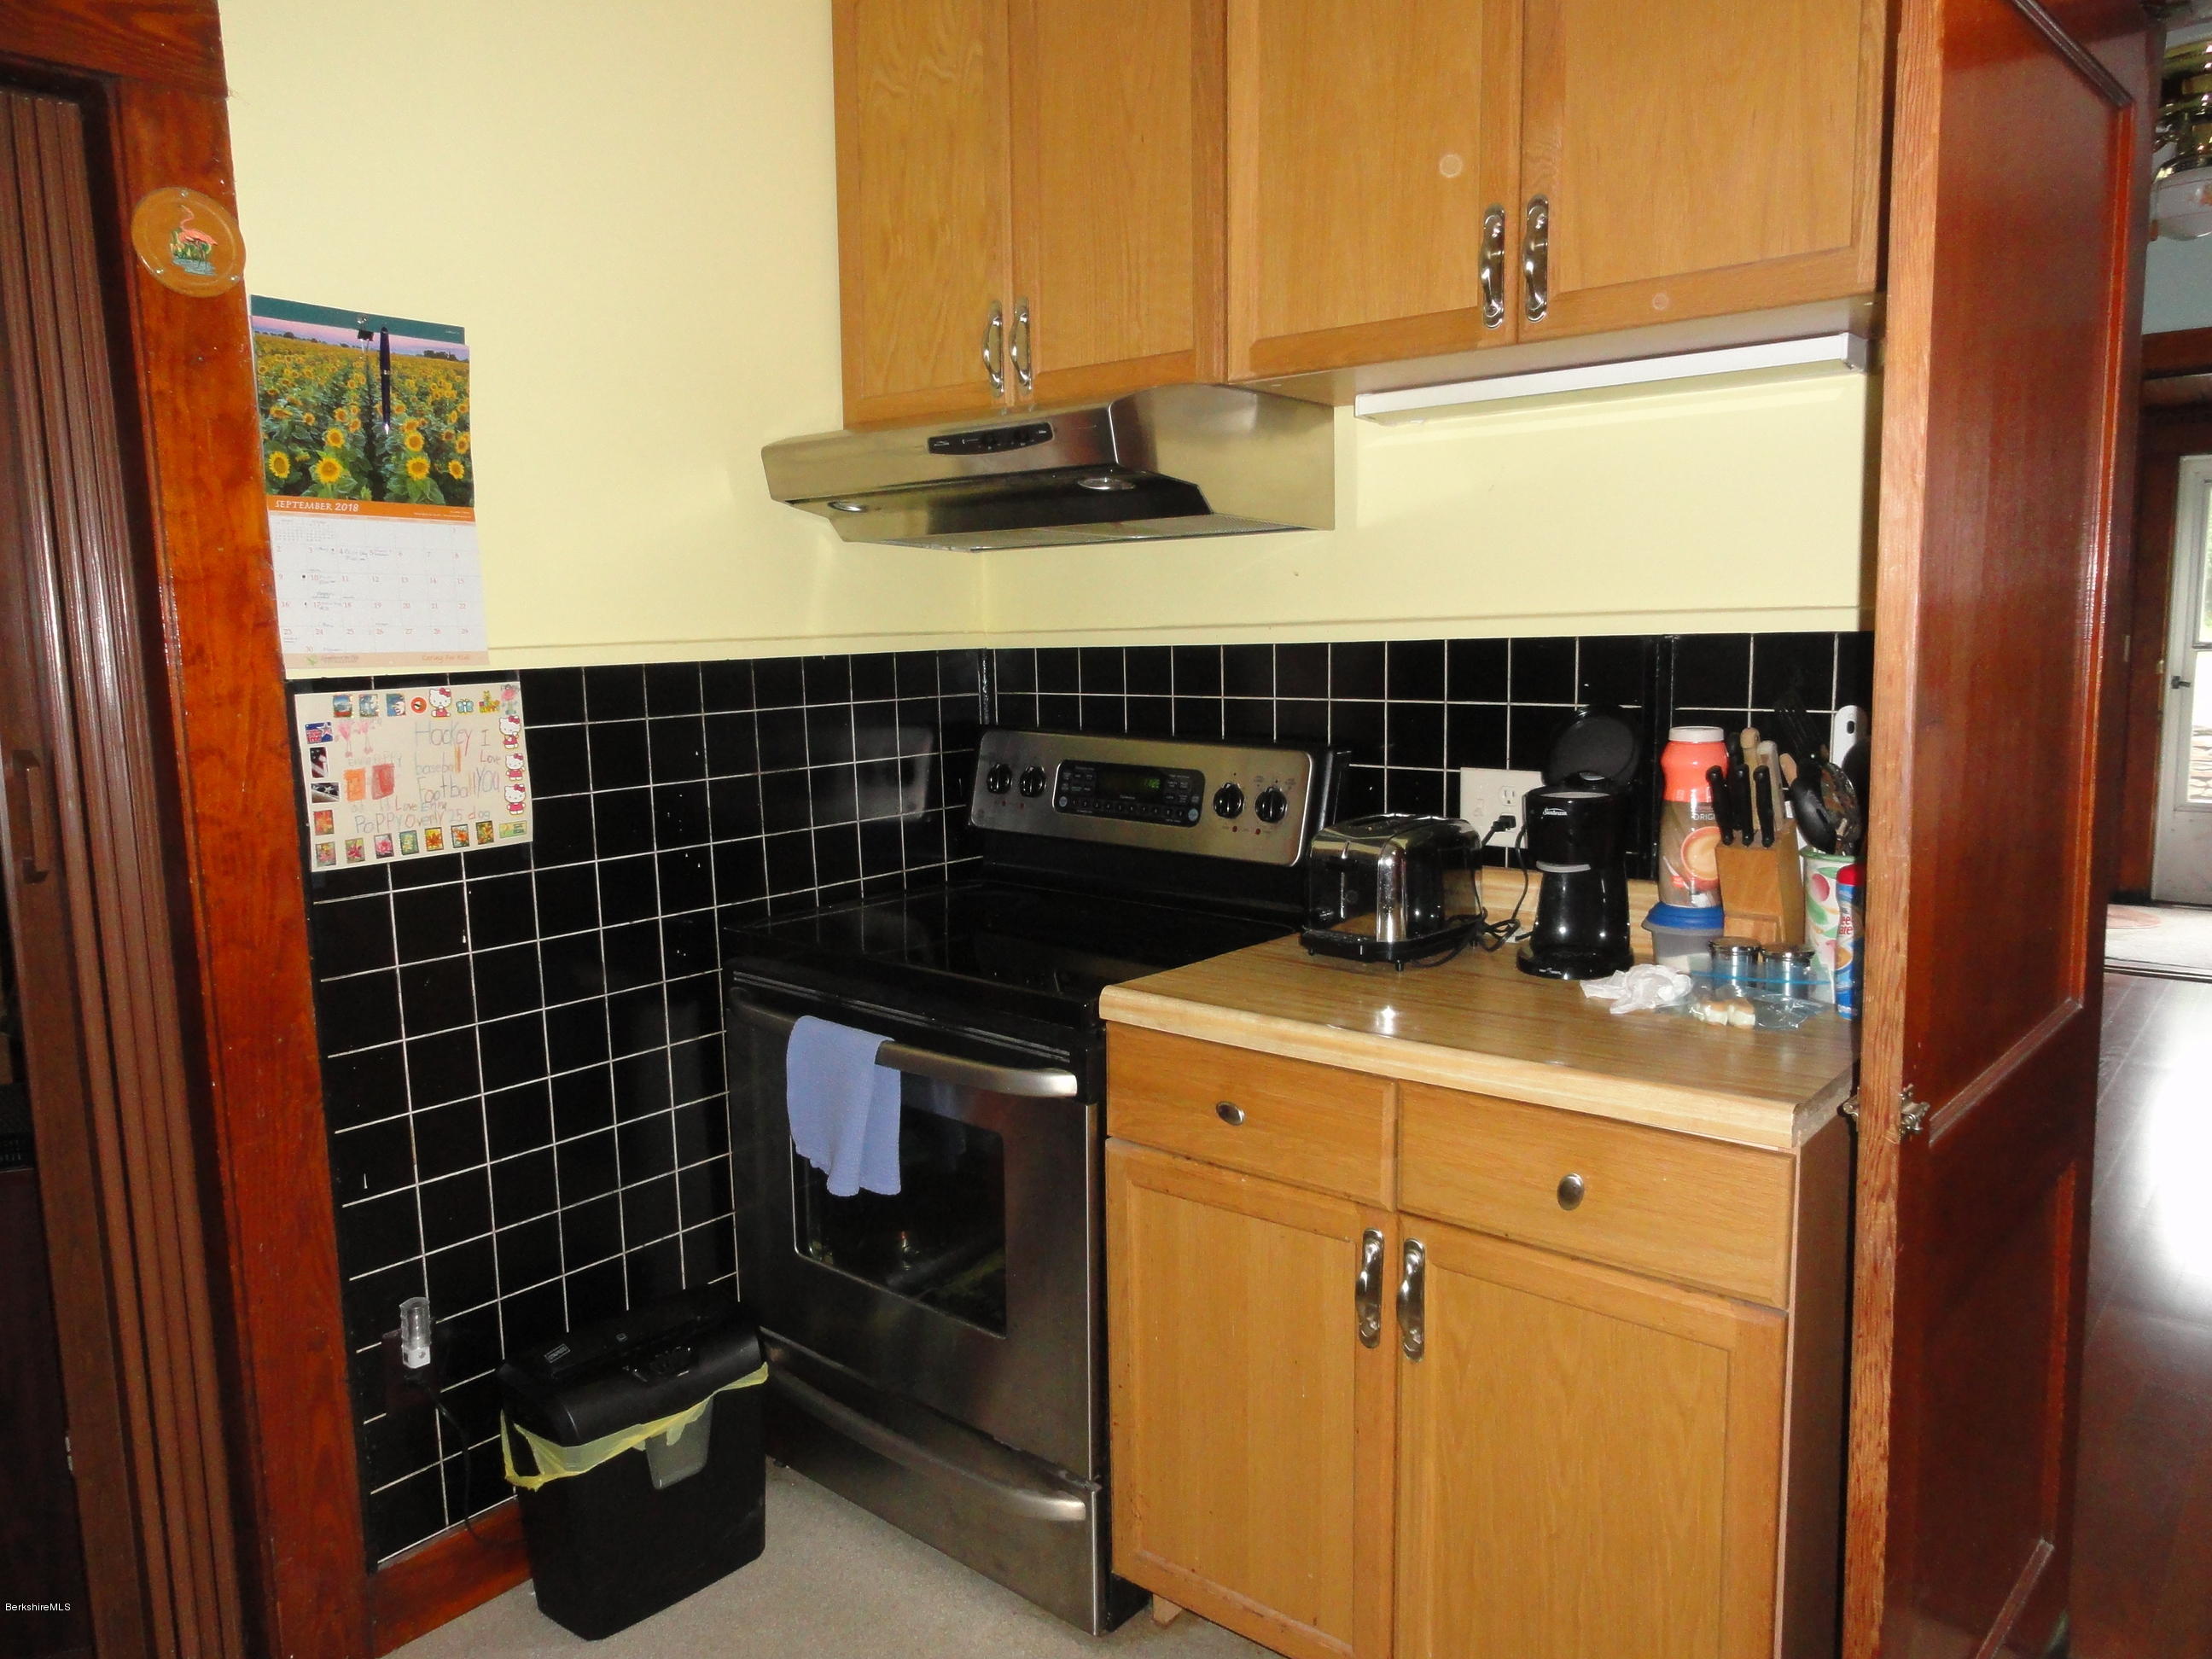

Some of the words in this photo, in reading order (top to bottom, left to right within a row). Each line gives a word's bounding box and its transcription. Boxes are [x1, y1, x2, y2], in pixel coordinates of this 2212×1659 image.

[275, 500, 332, 510] SEPTEMBER
[335, 503, 359, 512] 2018
[416, 720, 472, 756] Hockey
[481, 729, 491, 747] I
[480, 749, 502, 765] Love
[1693, 812, 1716, 821] ORIGI
